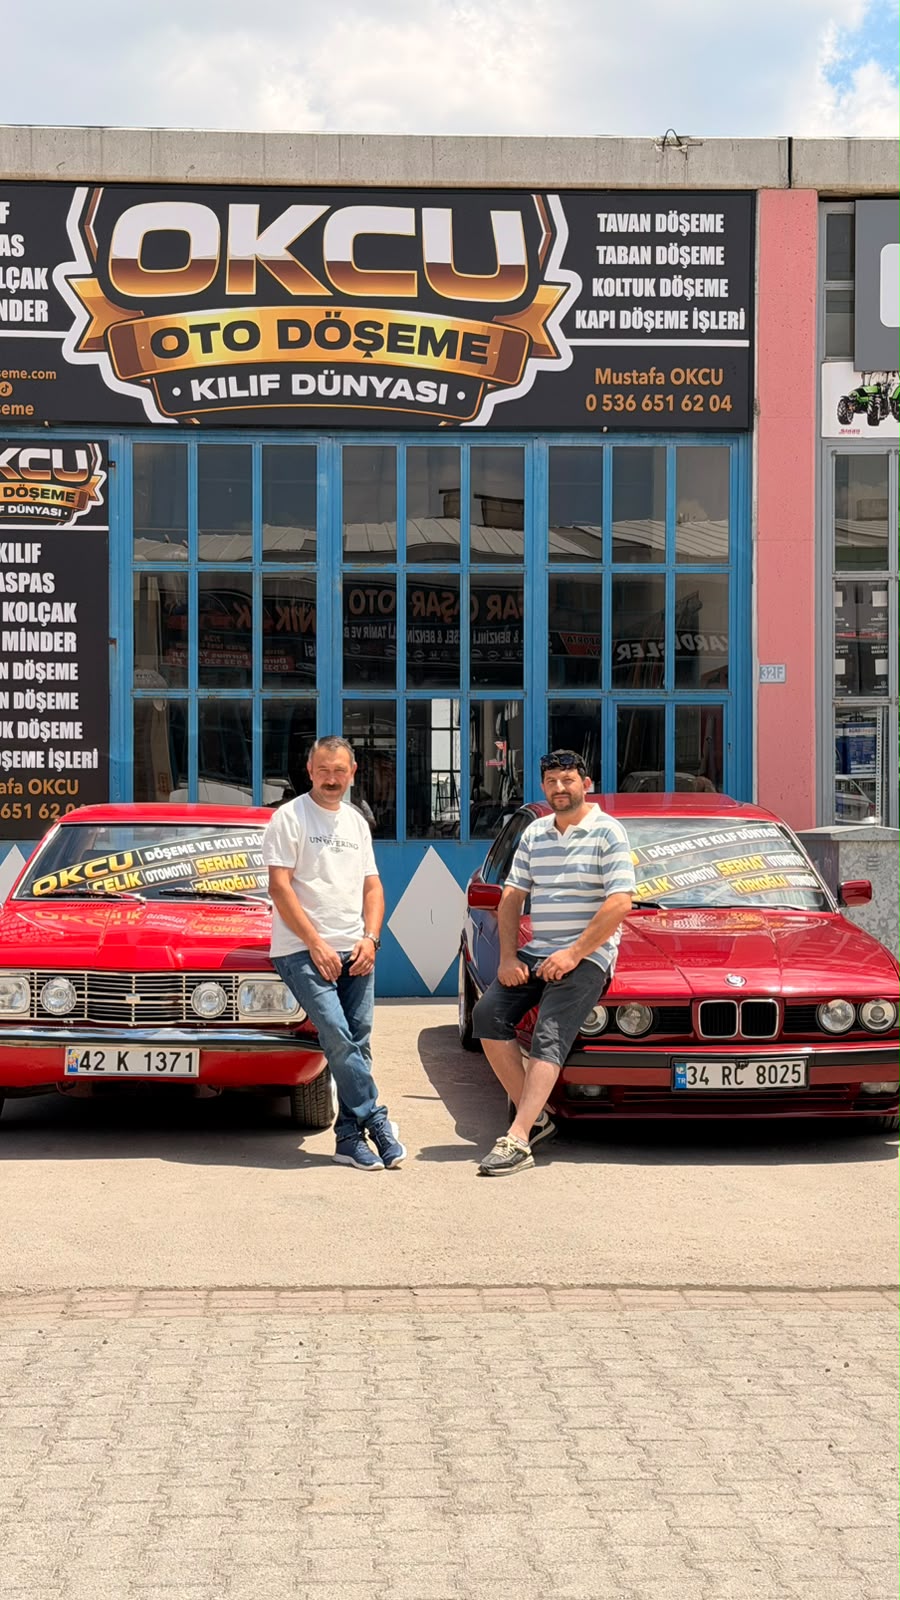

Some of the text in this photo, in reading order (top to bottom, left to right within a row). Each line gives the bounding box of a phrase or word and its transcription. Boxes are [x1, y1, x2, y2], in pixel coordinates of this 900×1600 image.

[597, 210, 724, 236] TAVAN DÖŞEME
[108, 201, 529, 303] OKCU
[596, 242, 724, 269] TABAN DÖŞEME
[592, 274, 729, 301] KOLTUK DÖŞEME
[575, 307, 745, 333] KAPI DÖŞEME İŞLERİ
[150, 310, 491, 365] OTO DÖŞEME
[190, 369, 449, 405] KILIF DÜNYASI
[594, 367, 724, 386] Mustafa OKCU
[585, 394, 733, 412] 0 536 651 62 04
[3, 484, 77, 503] DÖŞEME
[7, 503, 62, 517] DÜNYASI
[2, 601, 78, 627] KOLÇAK
[2, 628, 77, 652] MİNDER
[13, 659, 79, 683] DÖŞEME
[13, 689, 79, 713] DÖŞEME
[17, 718, 84, 743] DÖŞEME
[0, 747, 99, 772] ŞEME İŞLERİ
[28, 778, 79, 796] OKCU
[0, 803, 32, 819] 651
[38, 803, 60, 819] 62
[144, 843, 197, 862] DÖŞEME
[195, 840, 214, 852] VE
[214, 836, 244, 850] KILIF
[647, 840, 697, 859] DÖŞEME
[692, 837, 712, 848] VE
[708, 830, 738, 845] KILIF
[735, 828, 781, 841] DÜNYASI
[32, 852, 134, 897] OKCU
[144, 862, 193, 884] OTOMOTİV
[195, 852, 250, 875] SERHAT
[673, 866, 719, 887] OTOMOTİV
[715, 854, 768, 878] SERHAT
[730, 873, 789, 894] TÜRKOĞLU
[79, 1050, 194, 1073] 42 K 1371
[687, 1063, 802, 1086] 34 RC 8025
